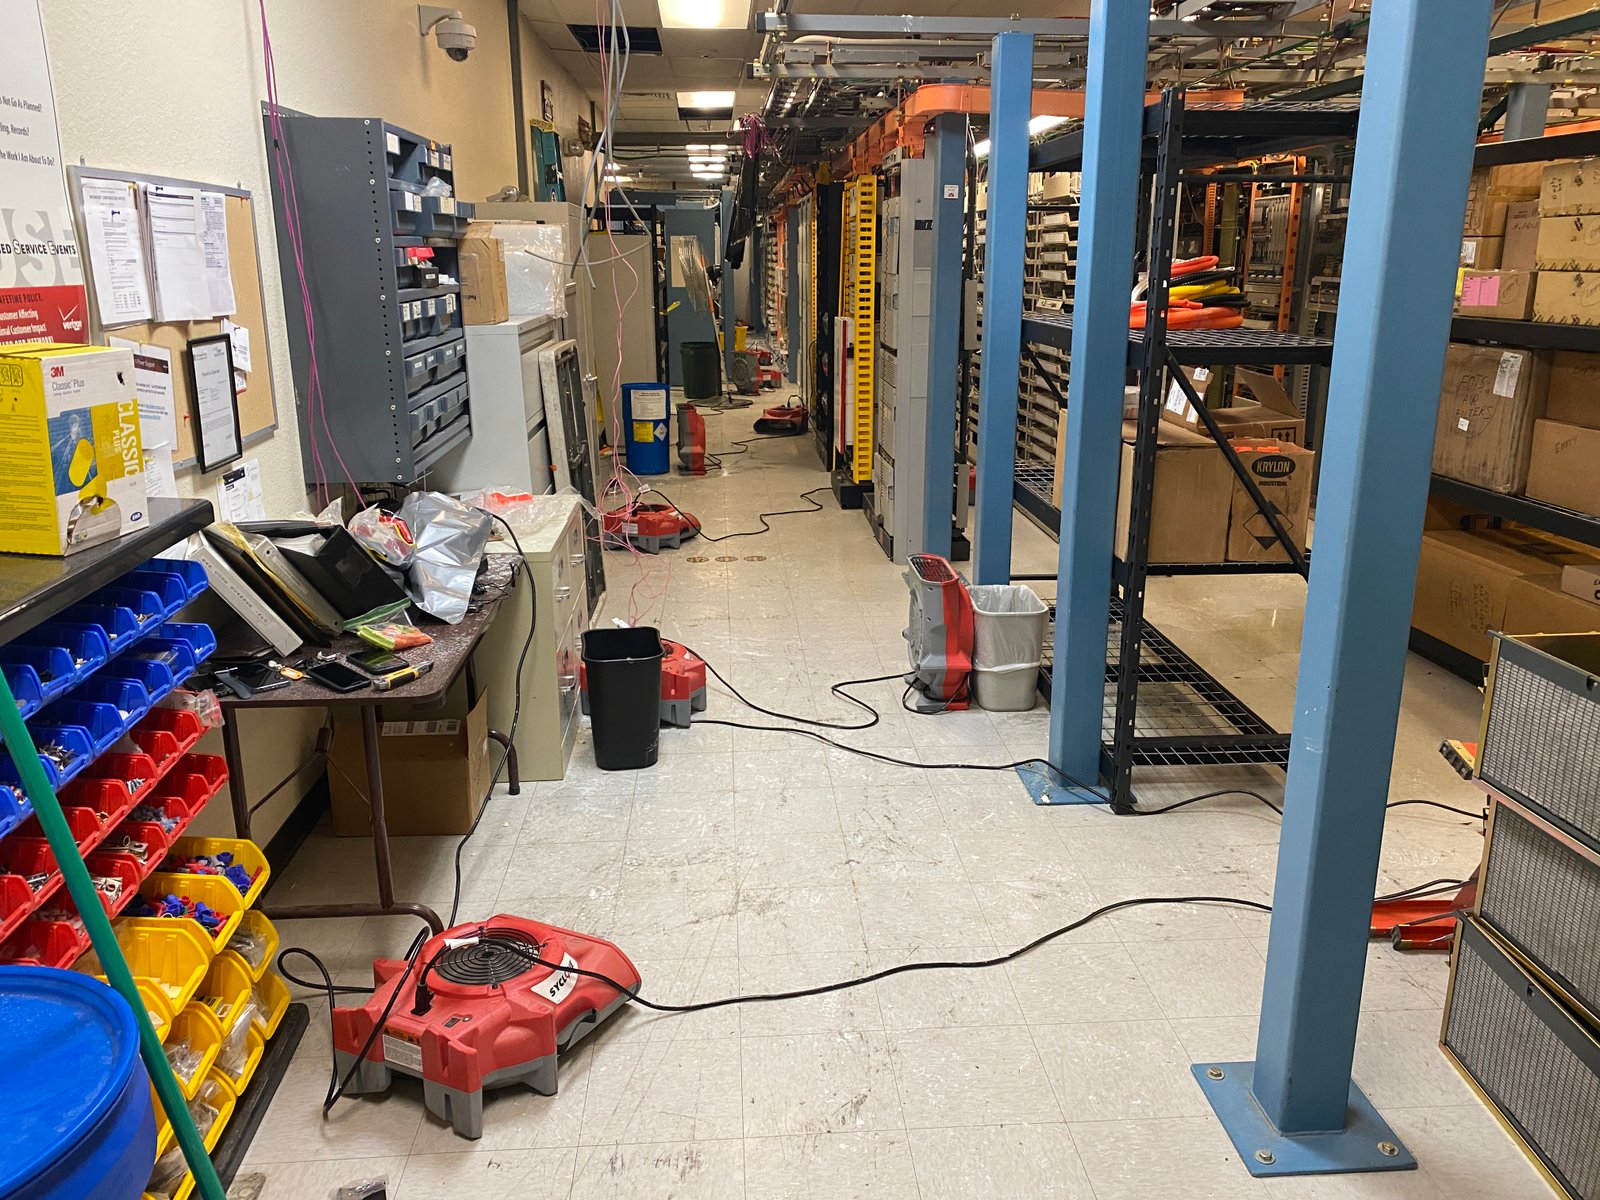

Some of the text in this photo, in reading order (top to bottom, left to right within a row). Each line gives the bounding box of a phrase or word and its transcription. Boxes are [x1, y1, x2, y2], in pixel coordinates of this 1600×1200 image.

[21, 152, 29, 163] Am
[29, 154, 41, 165] About
[13, 238, 48, 255] SERVICE
[48, 240, 77, 256] EVENTS
[10, 325, 31, 335] Customer
[31, 323, 47, 335] Impact
[50, 365, 64, 378] 3M
[52, 379, 85, 391] Classic Plus
[112, 428, 122, 454] PLUS
[117, 400, 140, 477] CLASSIC
[1256, 461, 1290, 473] KRYLON
